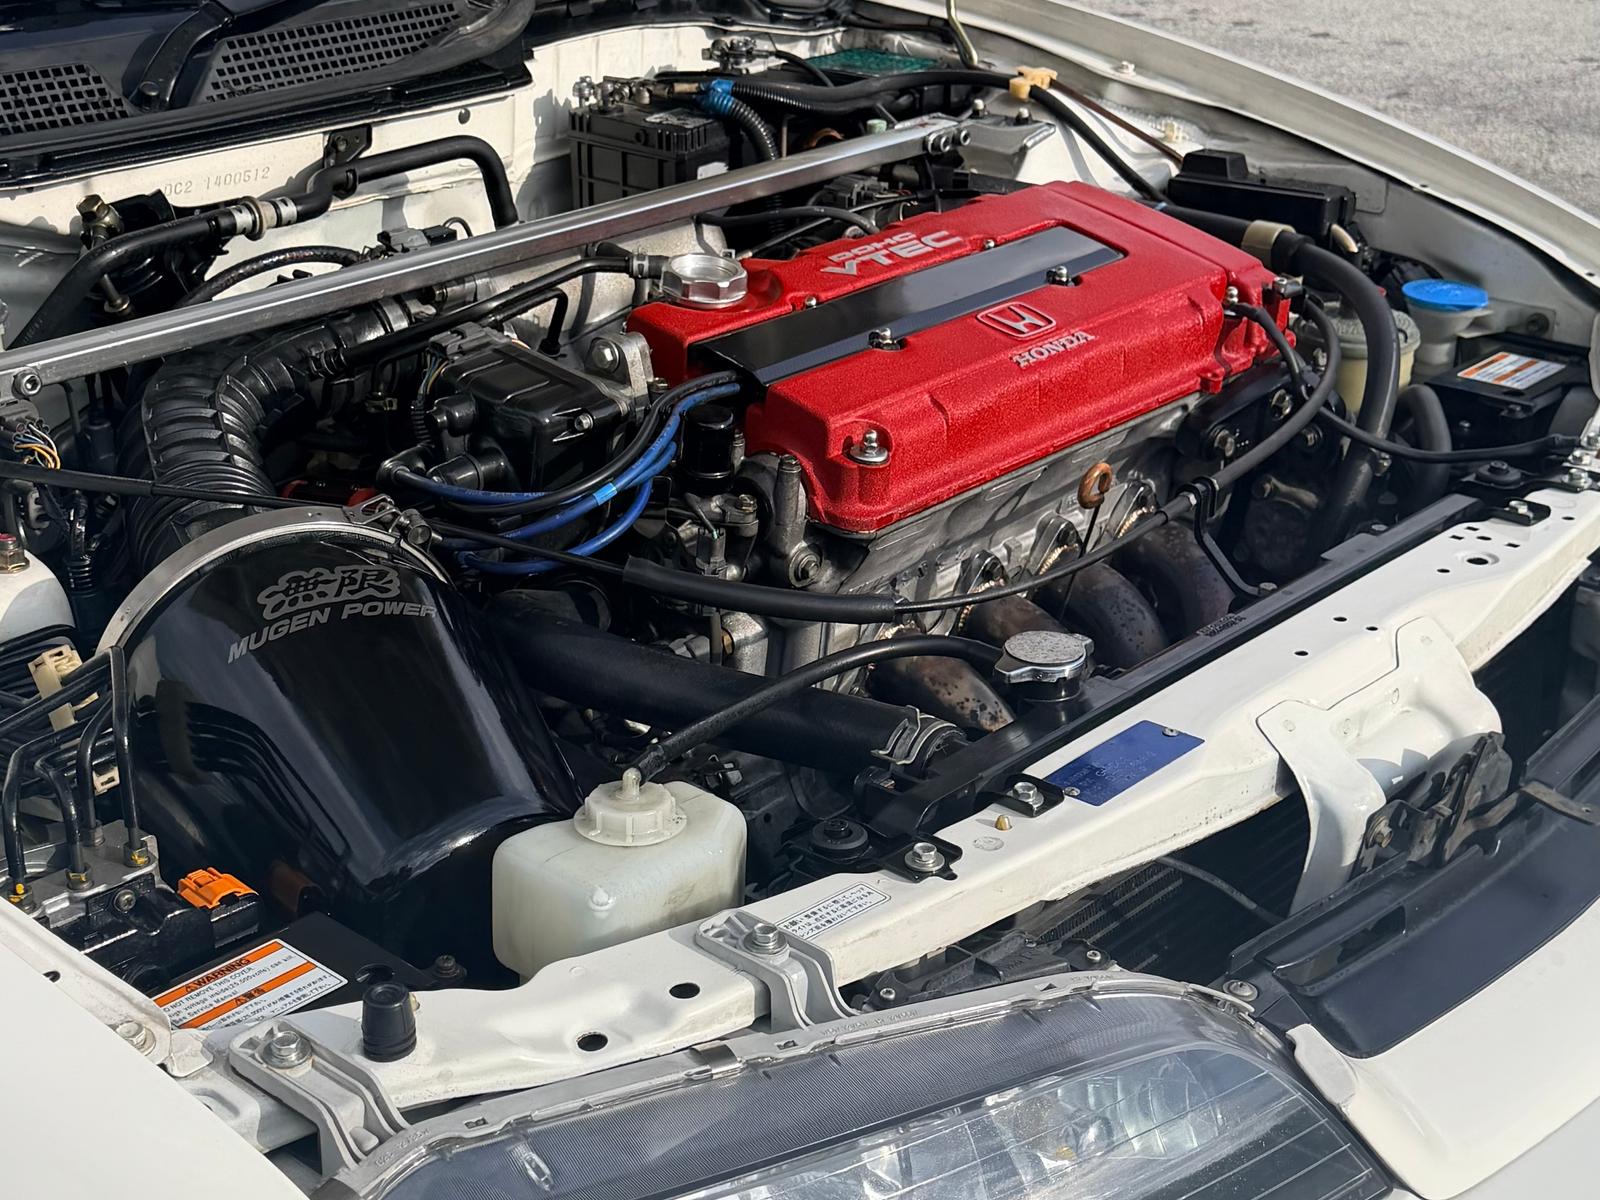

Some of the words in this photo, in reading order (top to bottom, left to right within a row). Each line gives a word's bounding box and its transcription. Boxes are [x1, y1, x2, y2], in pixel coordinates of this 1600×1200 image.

[164, 180, 193, 196] DC2
[820, 230, 963, 276] VTEC
[828, 231, 917, 262] DOHC
[1010, 331, 1096, 369] HONDA
[228, 607, 331, 664] MUGEN
[341, 602, 438, 620] POWER
[196, 958, 250, 987] WARNING
[185, 986, 214, 1001] REMOVE
